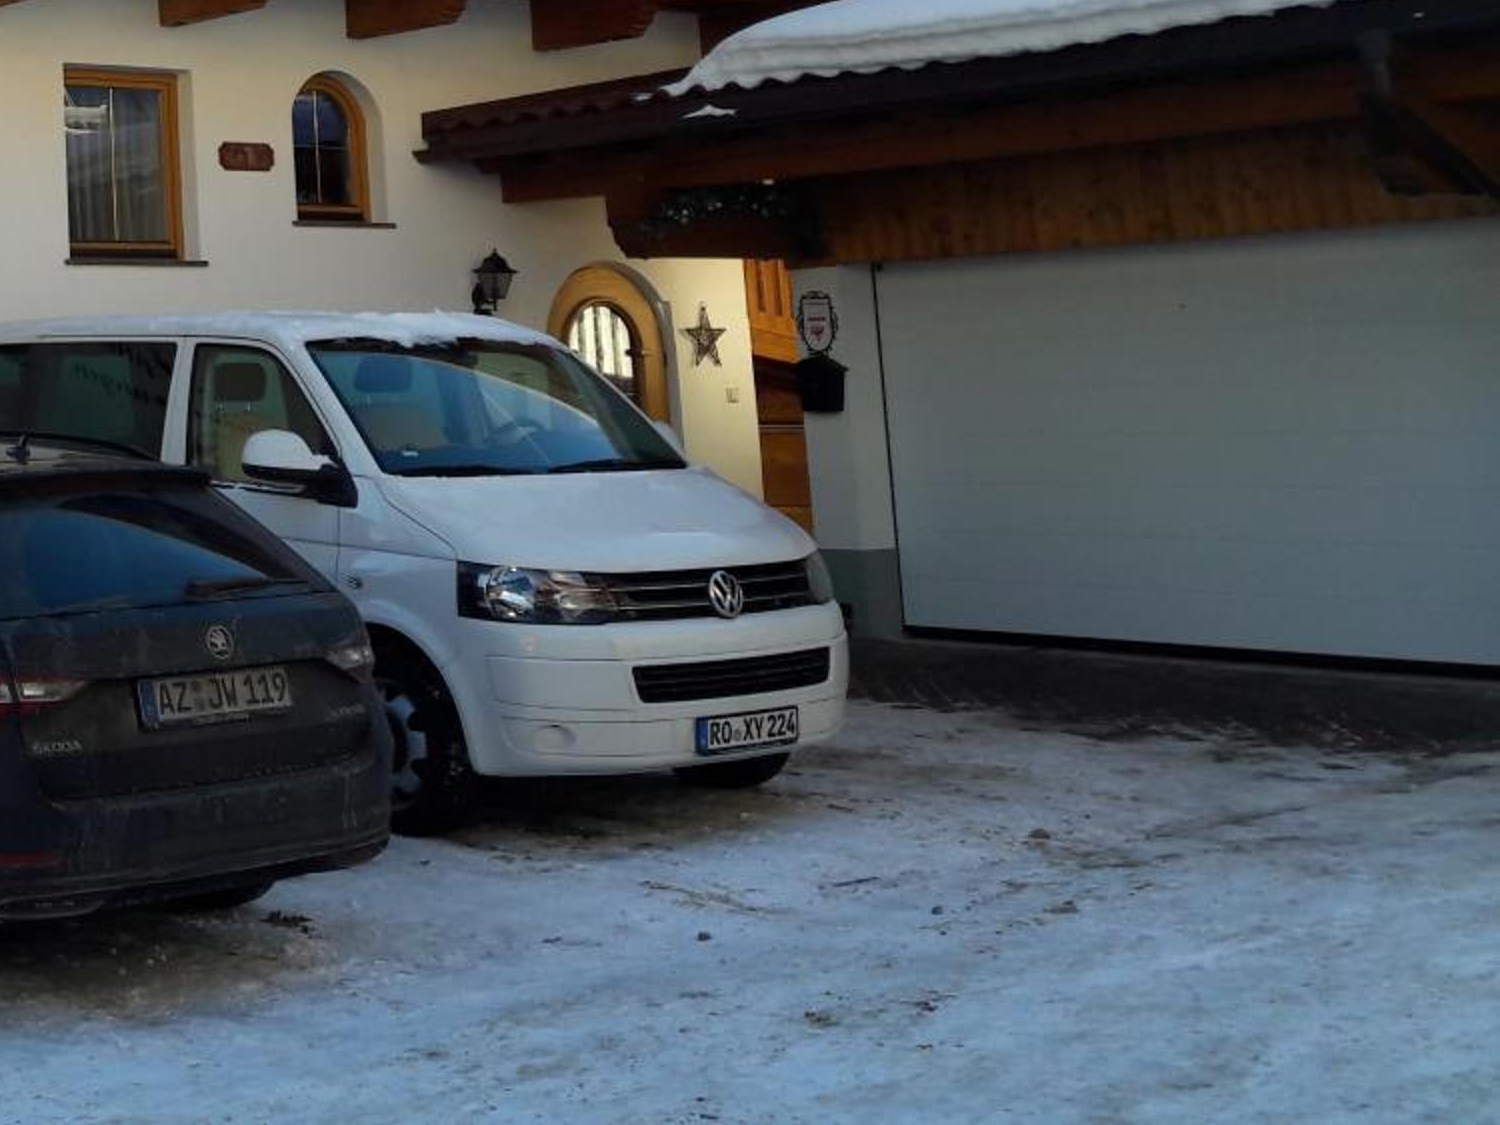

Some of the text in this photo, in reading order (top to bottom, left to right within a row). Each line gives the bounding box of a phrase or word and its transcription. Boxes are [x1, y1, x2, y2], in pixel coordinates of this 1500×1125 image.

[243, 671, 287, 705] 119
[708, 711, 796, 746] RO XY 224
